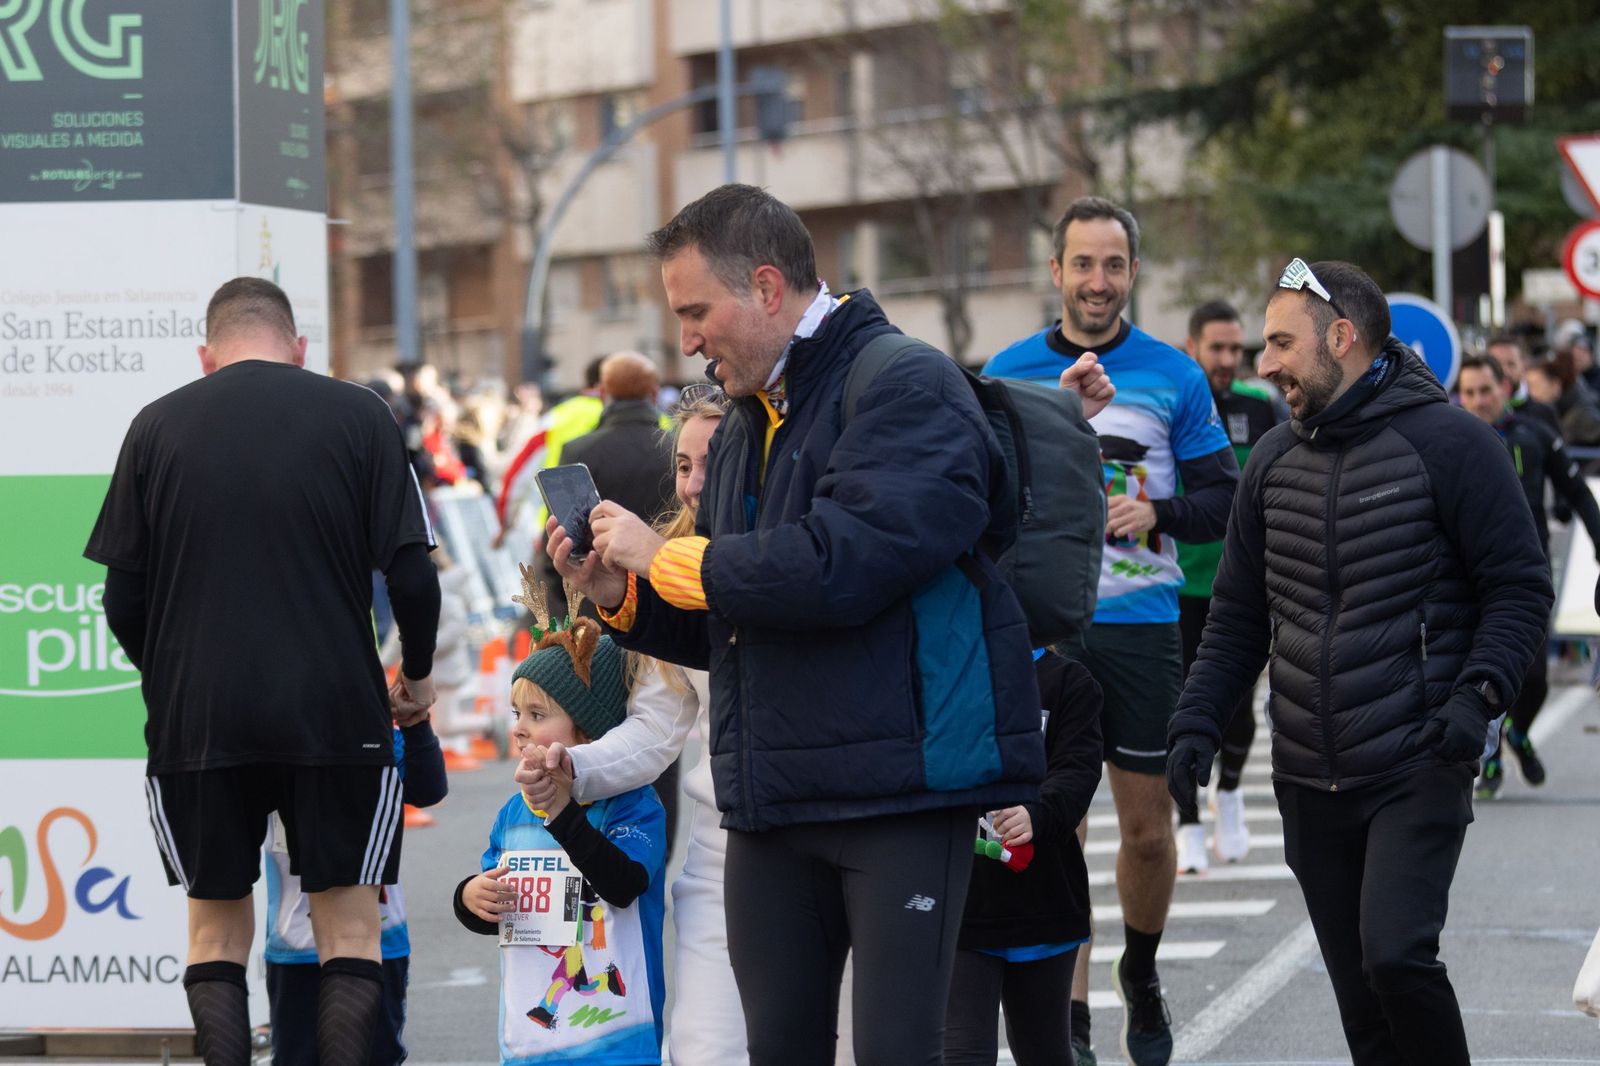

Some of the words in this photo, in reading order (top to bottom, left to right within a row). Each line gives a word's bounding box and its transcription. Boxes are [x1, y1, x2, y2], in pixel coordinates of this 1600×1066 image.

[52, 111, 144, 128] SOLUCIONES
[1, 132, 70, 149] VISUALES
[73, 132, 84, 148] A
[87, 131, 144, 147] MEDIDA
[1, 289, 51, 306] Colegio
[55, 290, 100, 304] Jesuita
[104, 293, 122, 303] en
[125, 289, 198, 303] Salamanca
[2, 311, 53, 340] San
[2, 346, 35, 374] de
[46, 345, 145, 374] Kostka
[1, 382, 41, 398] desde
[506, 913, 529, 922] OLIVER
[519, 935, 541, 943] Salamanca
